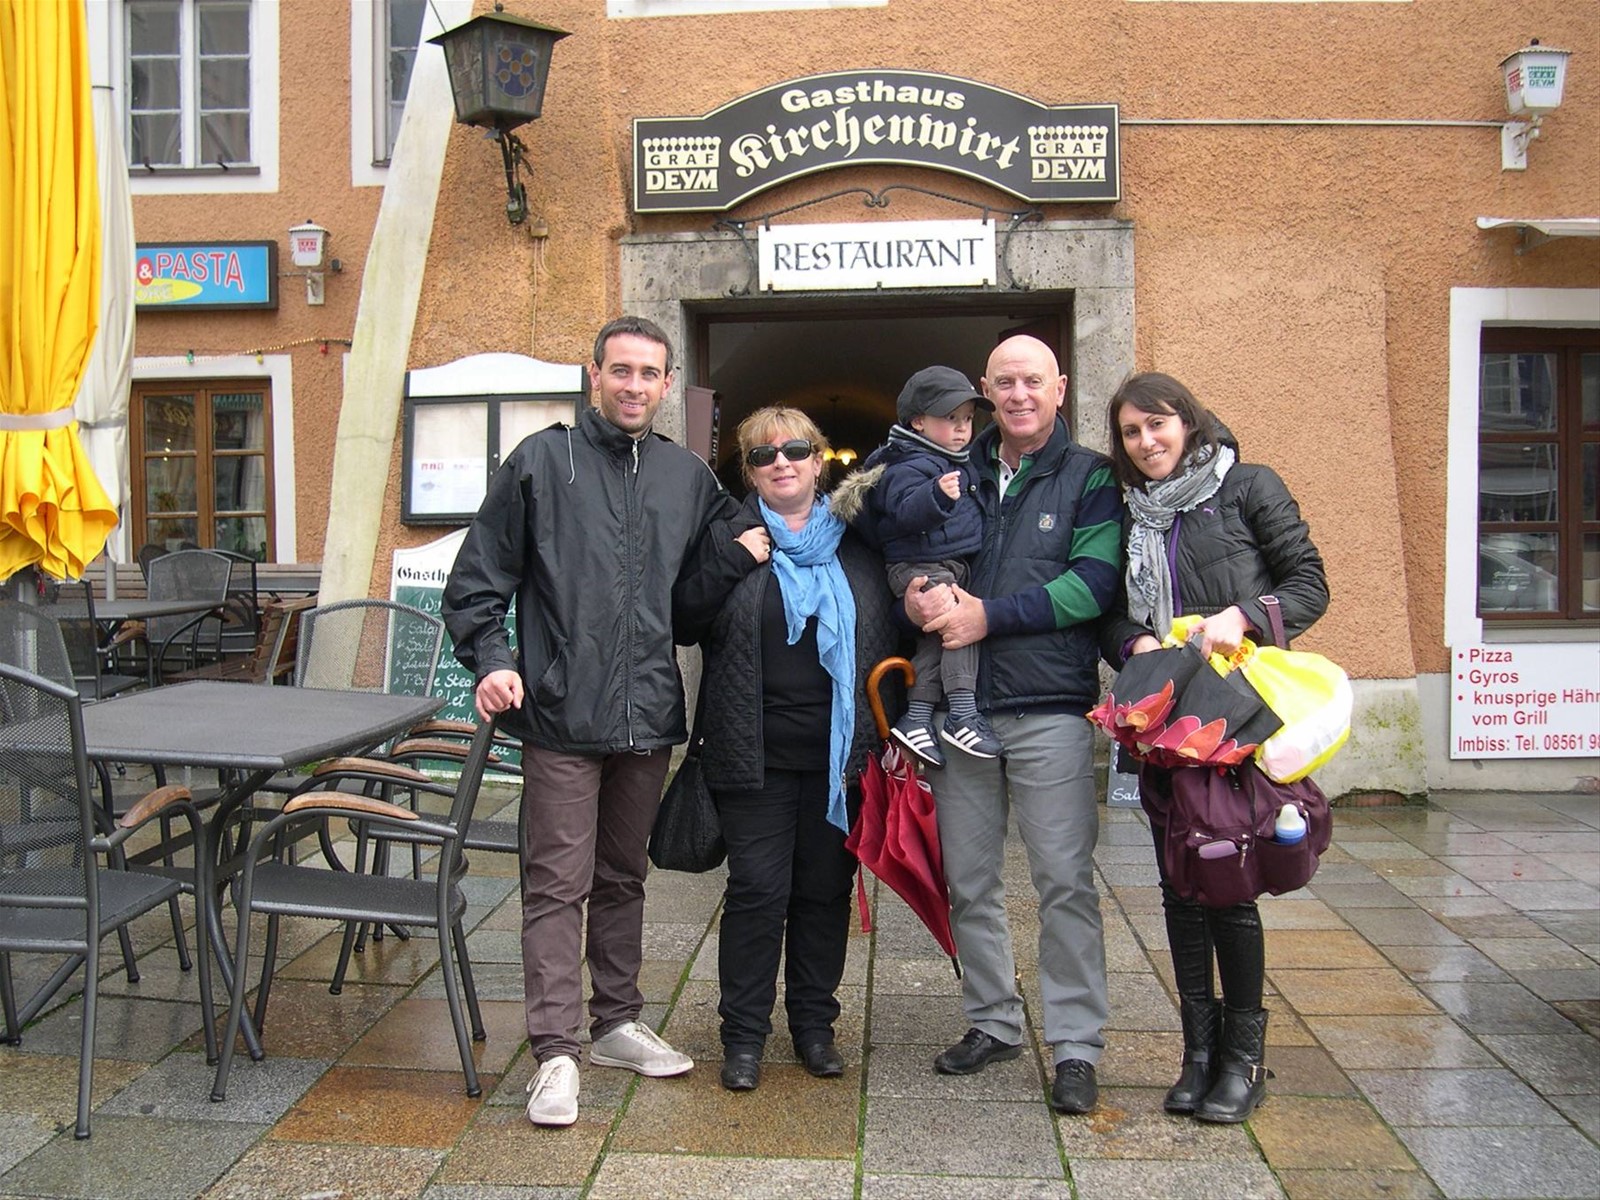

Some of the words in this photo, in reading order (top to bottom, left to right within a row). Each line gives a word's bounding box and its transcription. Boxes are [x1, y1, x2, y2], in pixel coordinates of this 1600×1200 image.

[781, 80, 966, 112] Gasthaus
[729, 106, 1021, 177] Kirchenwirt
[1035, 143, 1102, 154] GRAF
[650, 153, 715, 165] GRAF
[1032, 158, 1106, 179] DEYM
[646, 169, 718, 190] DEYM
[773, 238, 984, 271] RESTAURANT
[156, 252, 245, 292] PASTA
[1470, 649, 1512, 662] Pizza
[1469, 670, 1519, 687] Gyros
[1474, 691, 1557, 707] knusprige
[1472, 715, 1507, 725] vom
[1514, 711, 1548, 725] Grill
[1459, 736, 1510, 751] Imbiss:
[1515, 735, 1539, 750] Tel.
[1544, 735, 1583, 750] 08561
[1111, 787, 1141, 801] Sal
